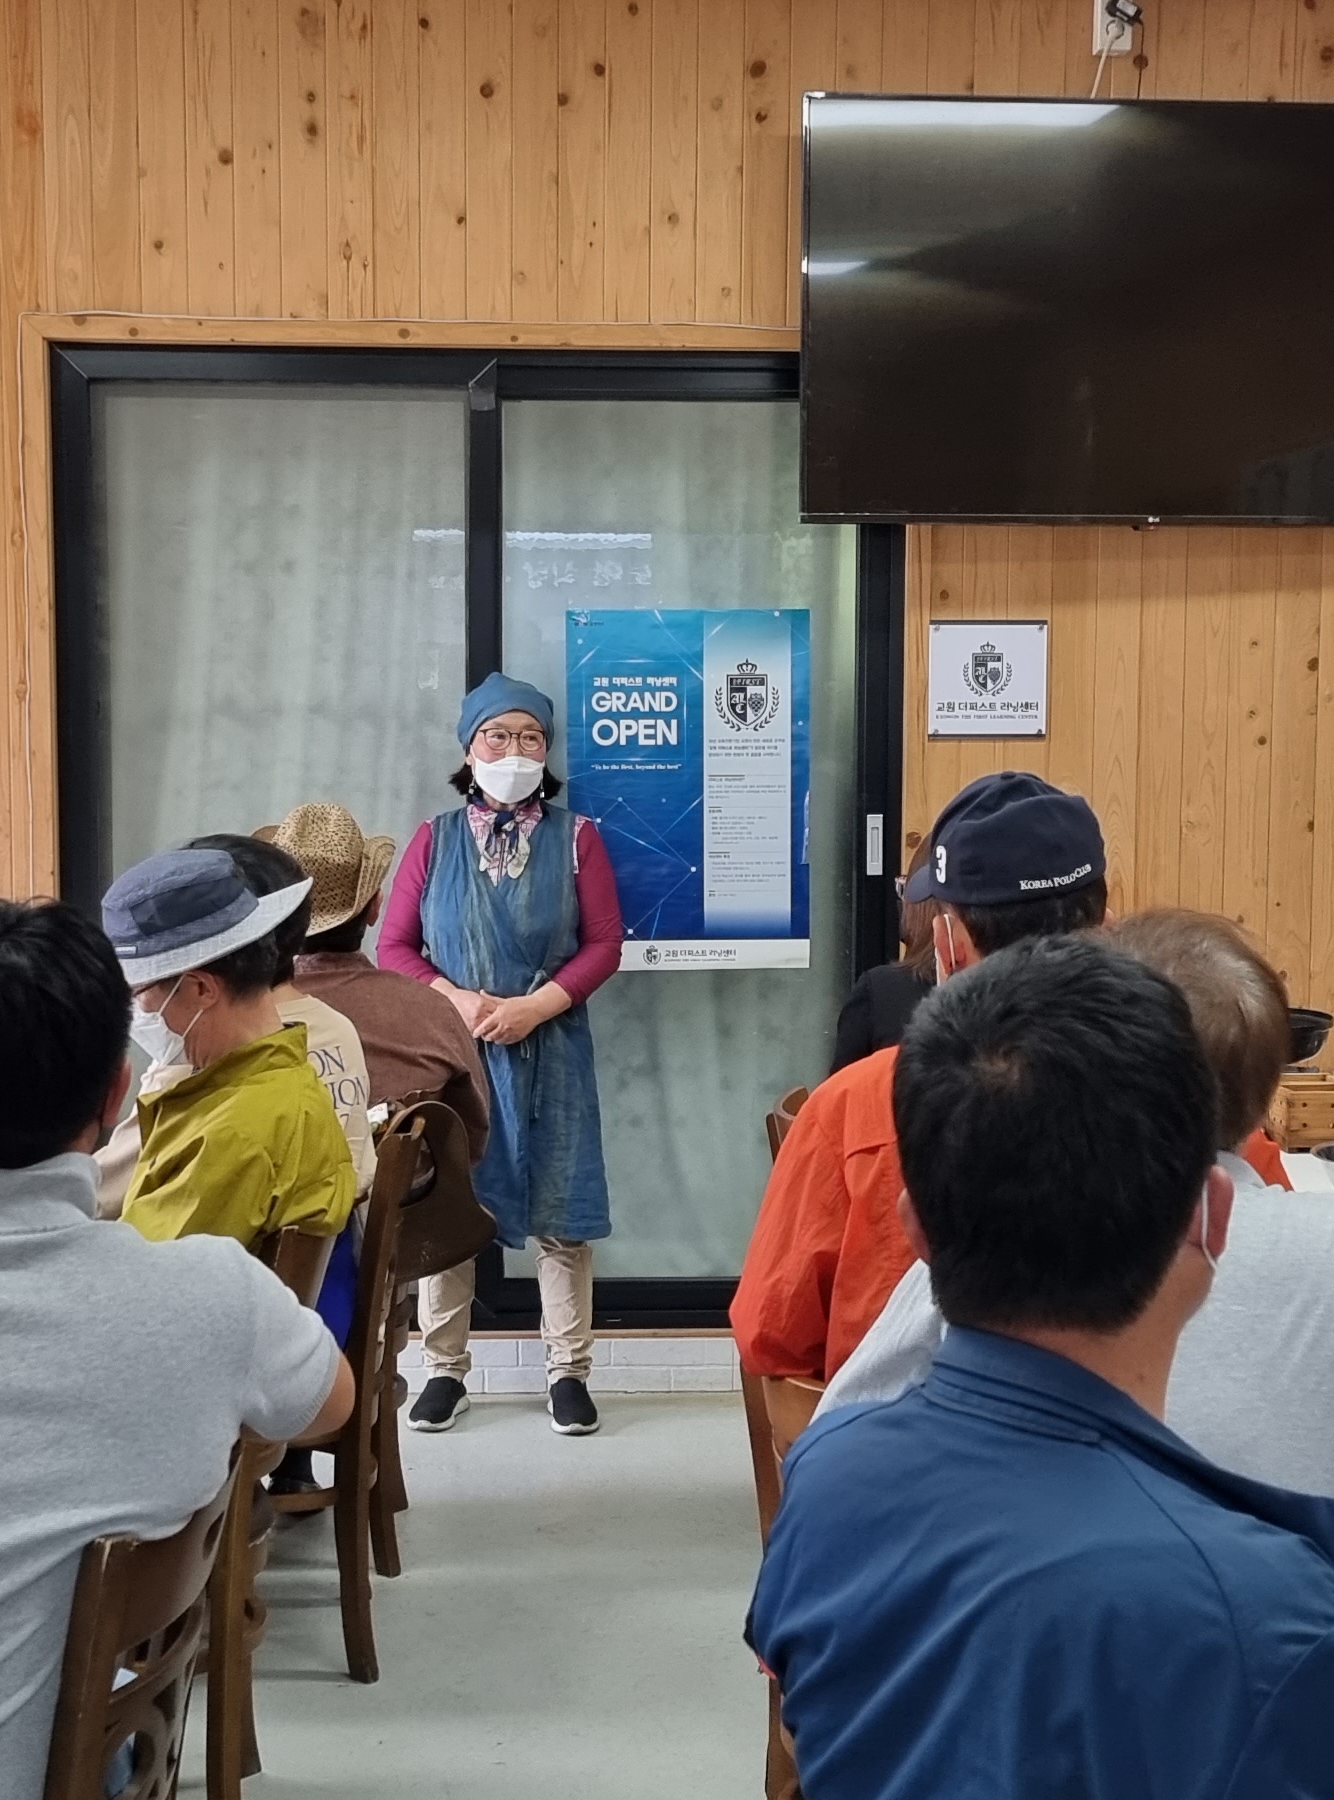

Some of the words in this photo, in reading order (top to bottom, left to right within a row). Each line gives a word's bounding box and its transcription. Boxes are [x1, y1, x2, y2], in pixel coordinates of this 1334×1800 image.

[591, 691, 678, 713] GRAND
[936, 701, 955, 712] 교원
[958, 701, 997, 711] 더퍼스트
[1000, 701, 1039, 712] 러닝센터
[592, 718, 678, 746] OPEN
[935, 845, 947, 884] 3
[1019, 880, 1053, 890] KOREA
[1053, 873, 1076, 887] POLO
